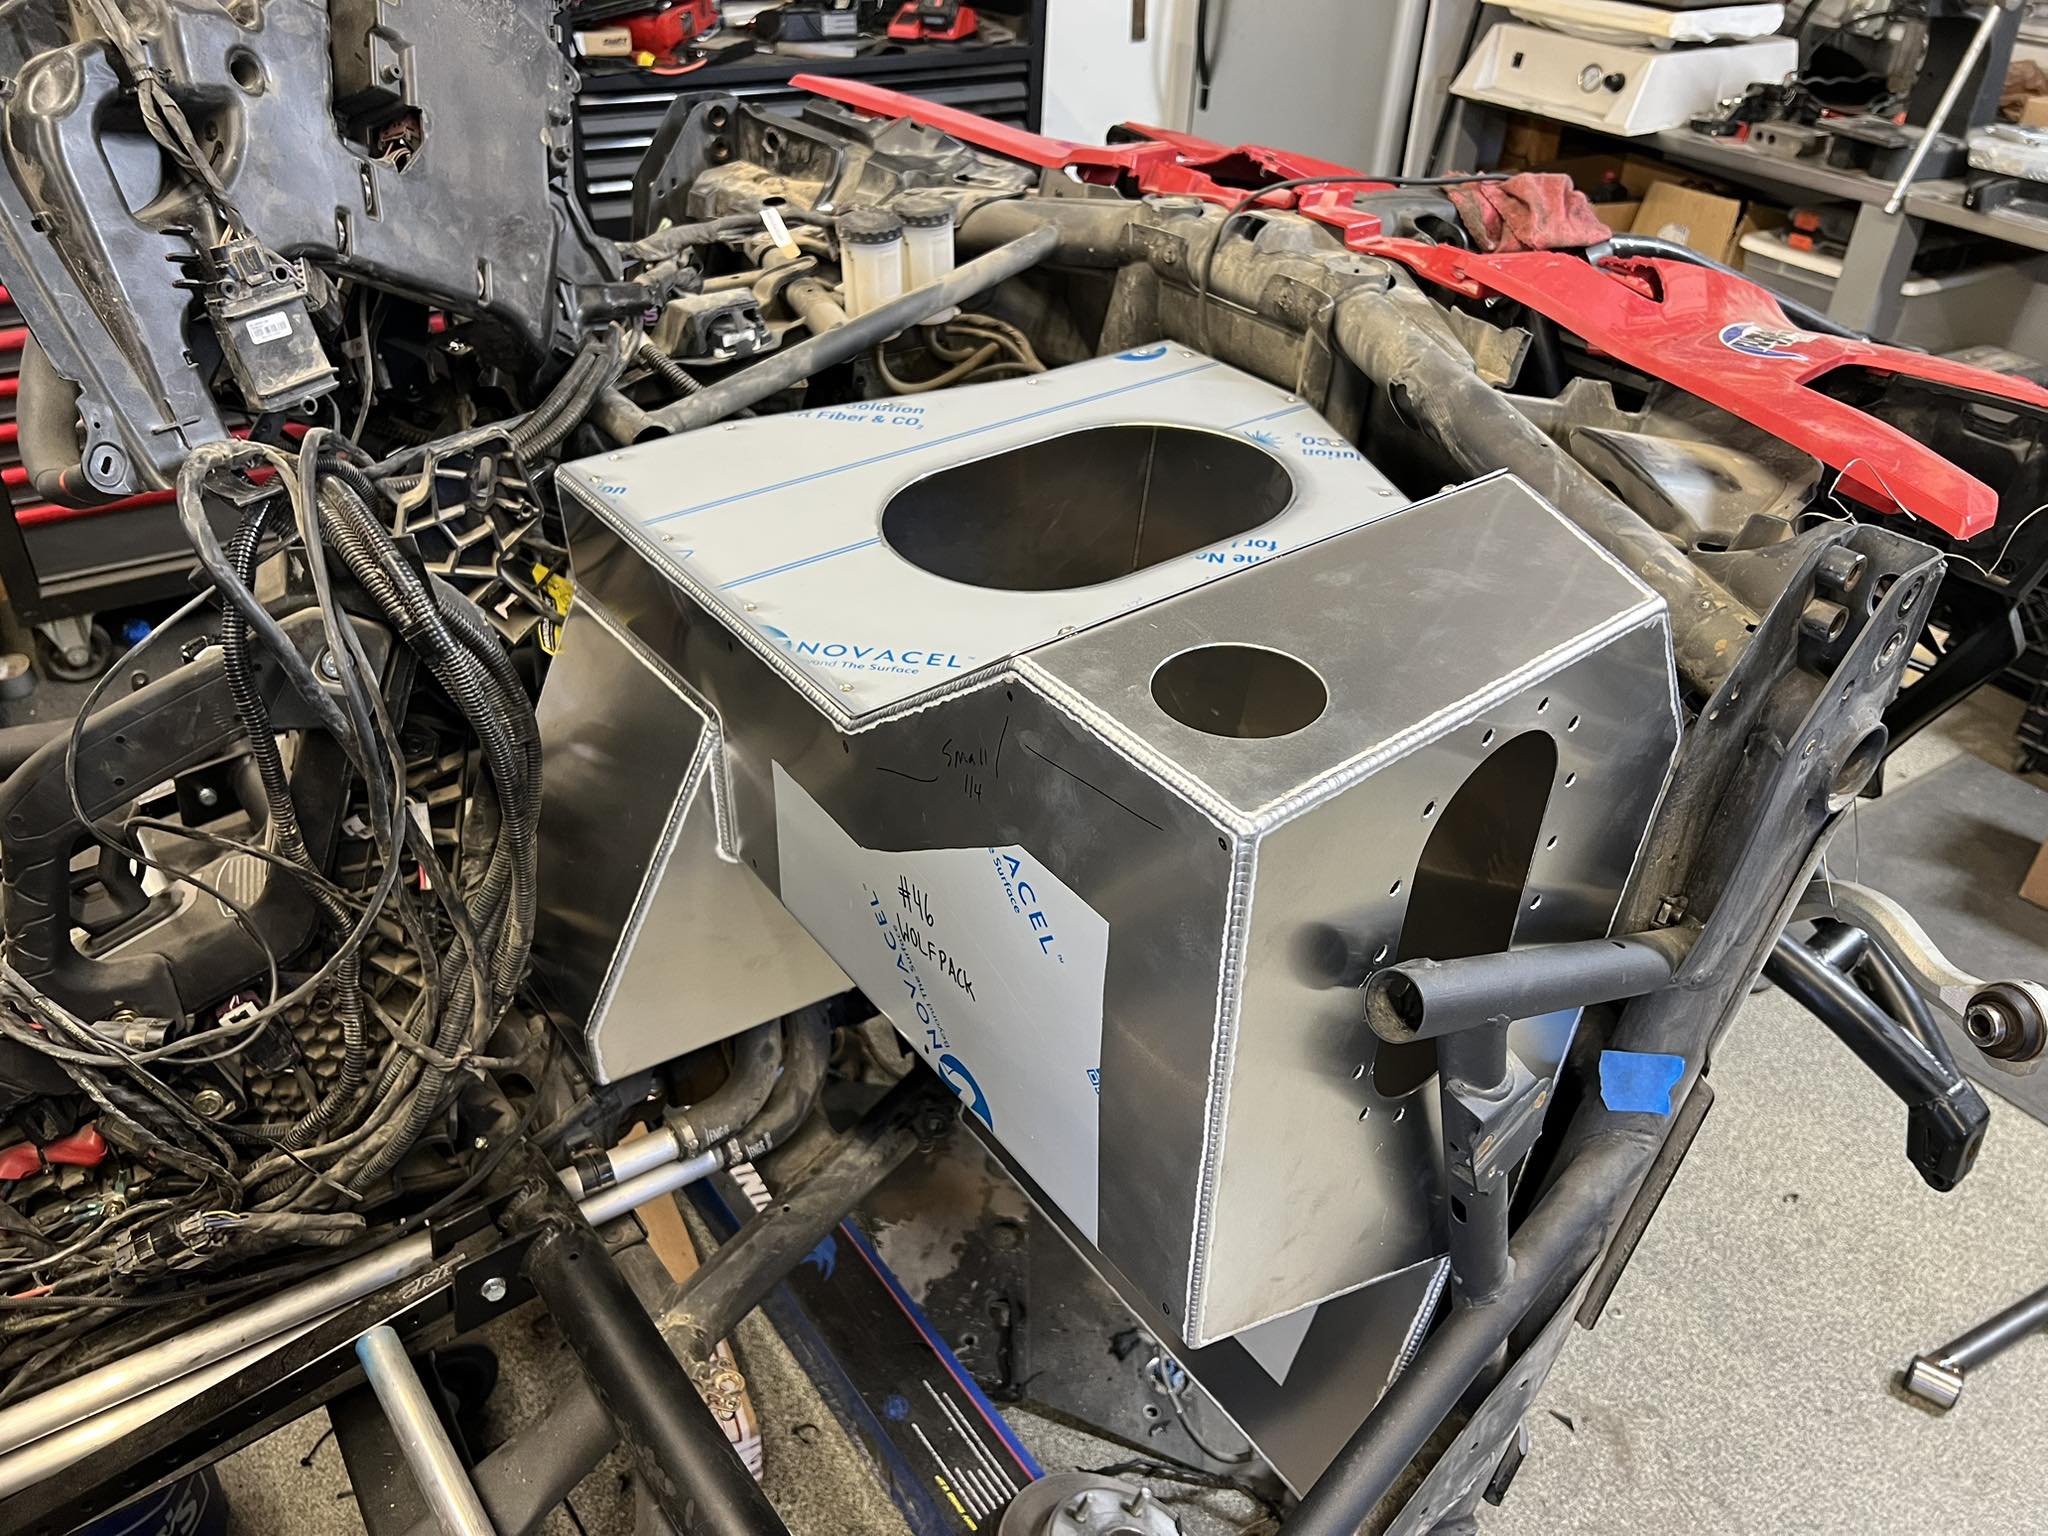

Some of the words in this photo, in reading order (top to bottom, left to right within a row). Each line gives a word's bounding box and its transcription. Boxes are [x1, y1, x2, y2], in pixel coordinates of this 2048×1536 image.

[815, 411, 868, 422] Fiber
[1244, 539, 1278, 551] for
[842, 660, 865, 670] The
[869, 663, 920, 675] Surface
[992, 857, 1021, 914] Surface
[897, 874, 934, 928] #46
[914, 975, 928, 999] The
[926, 1003, 950, 1048] Beyond
